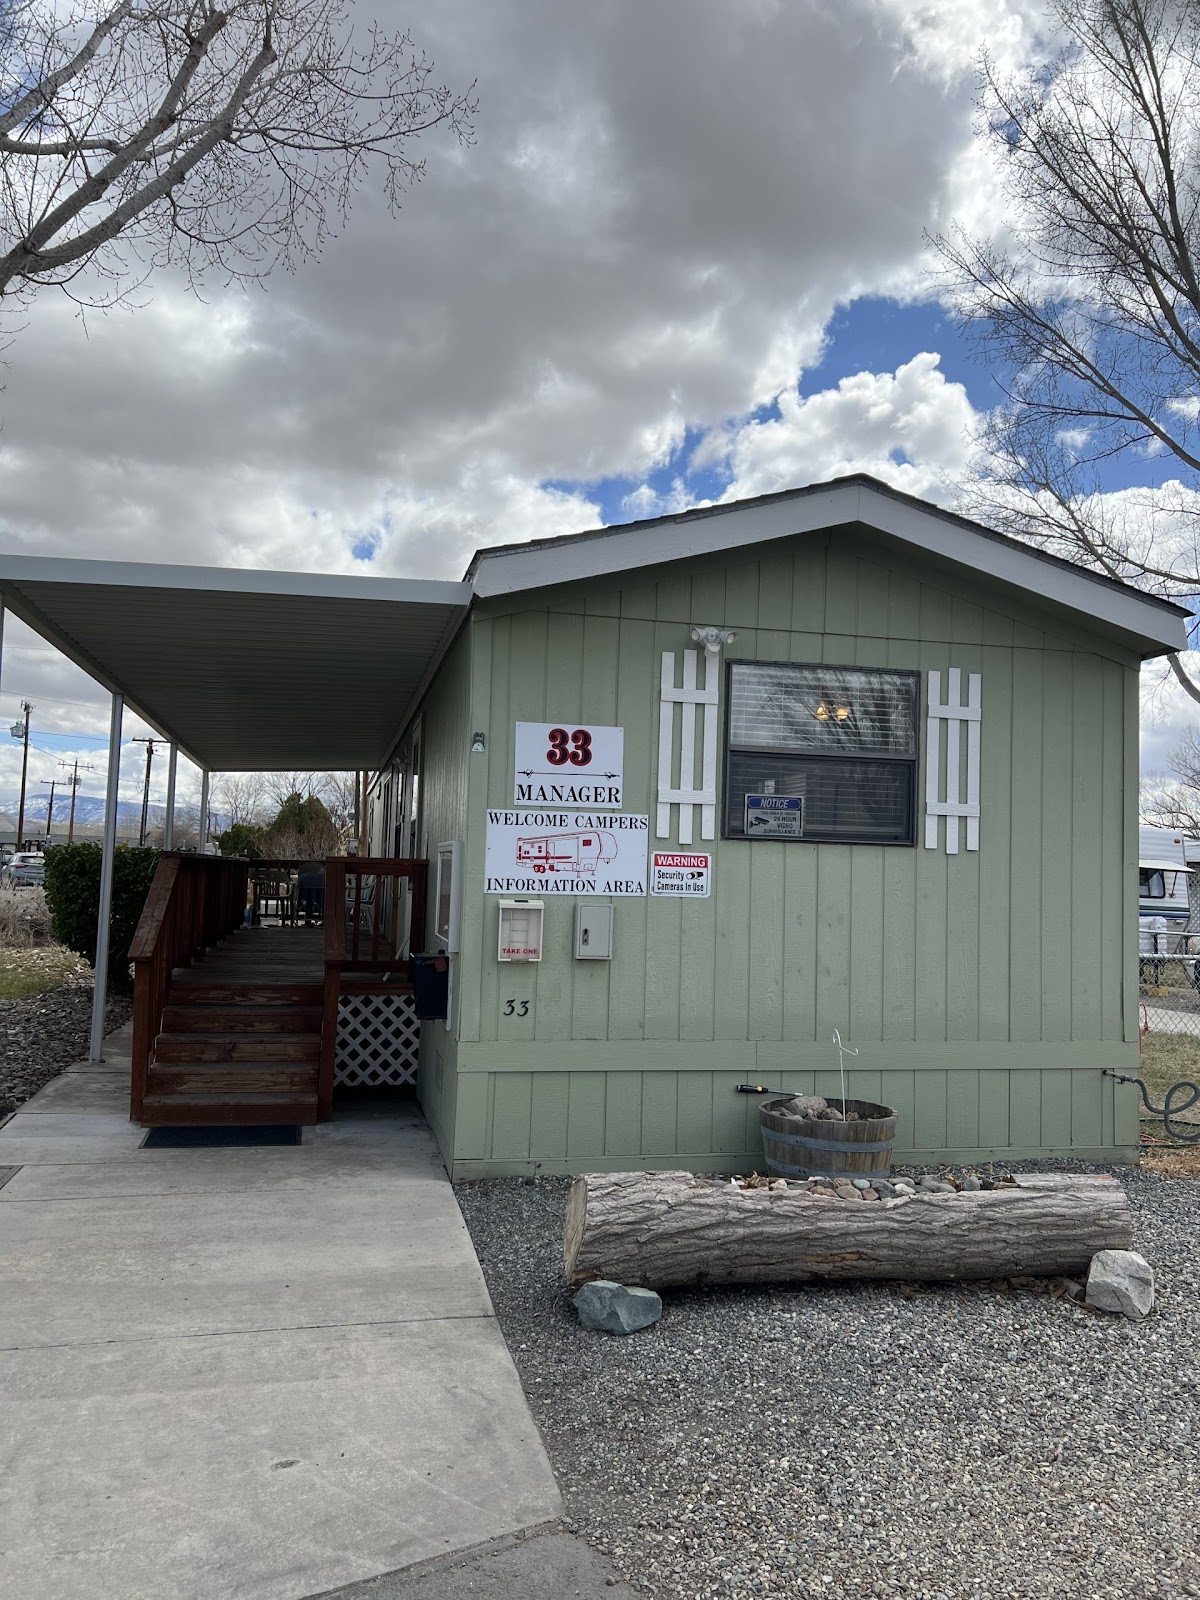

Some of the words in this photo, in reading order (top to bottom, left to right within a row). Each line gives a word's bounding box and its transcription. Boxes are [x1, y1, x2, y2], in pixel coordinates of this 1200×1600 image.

[546, 728, 592, 766] 33
[515, 784, 621, 804] MANAGER
[760, 798, 789, 809] NOTICE
[488, 812, 569, 828] WELCOME
[575, 815, 649, 830] CAMPERS
[657, 855, 706, 867] WARNING
[657, 869, 684, 881] Security
[486, 877, 597, 893] INFORMATION
[602, 880, 644, 894] AREA
[657, 881, 684, 891] Cameras
[685, 882, 691, 891] In
[693, 883, 704, 892] Use
[503, 998, 530, 1017] 33
